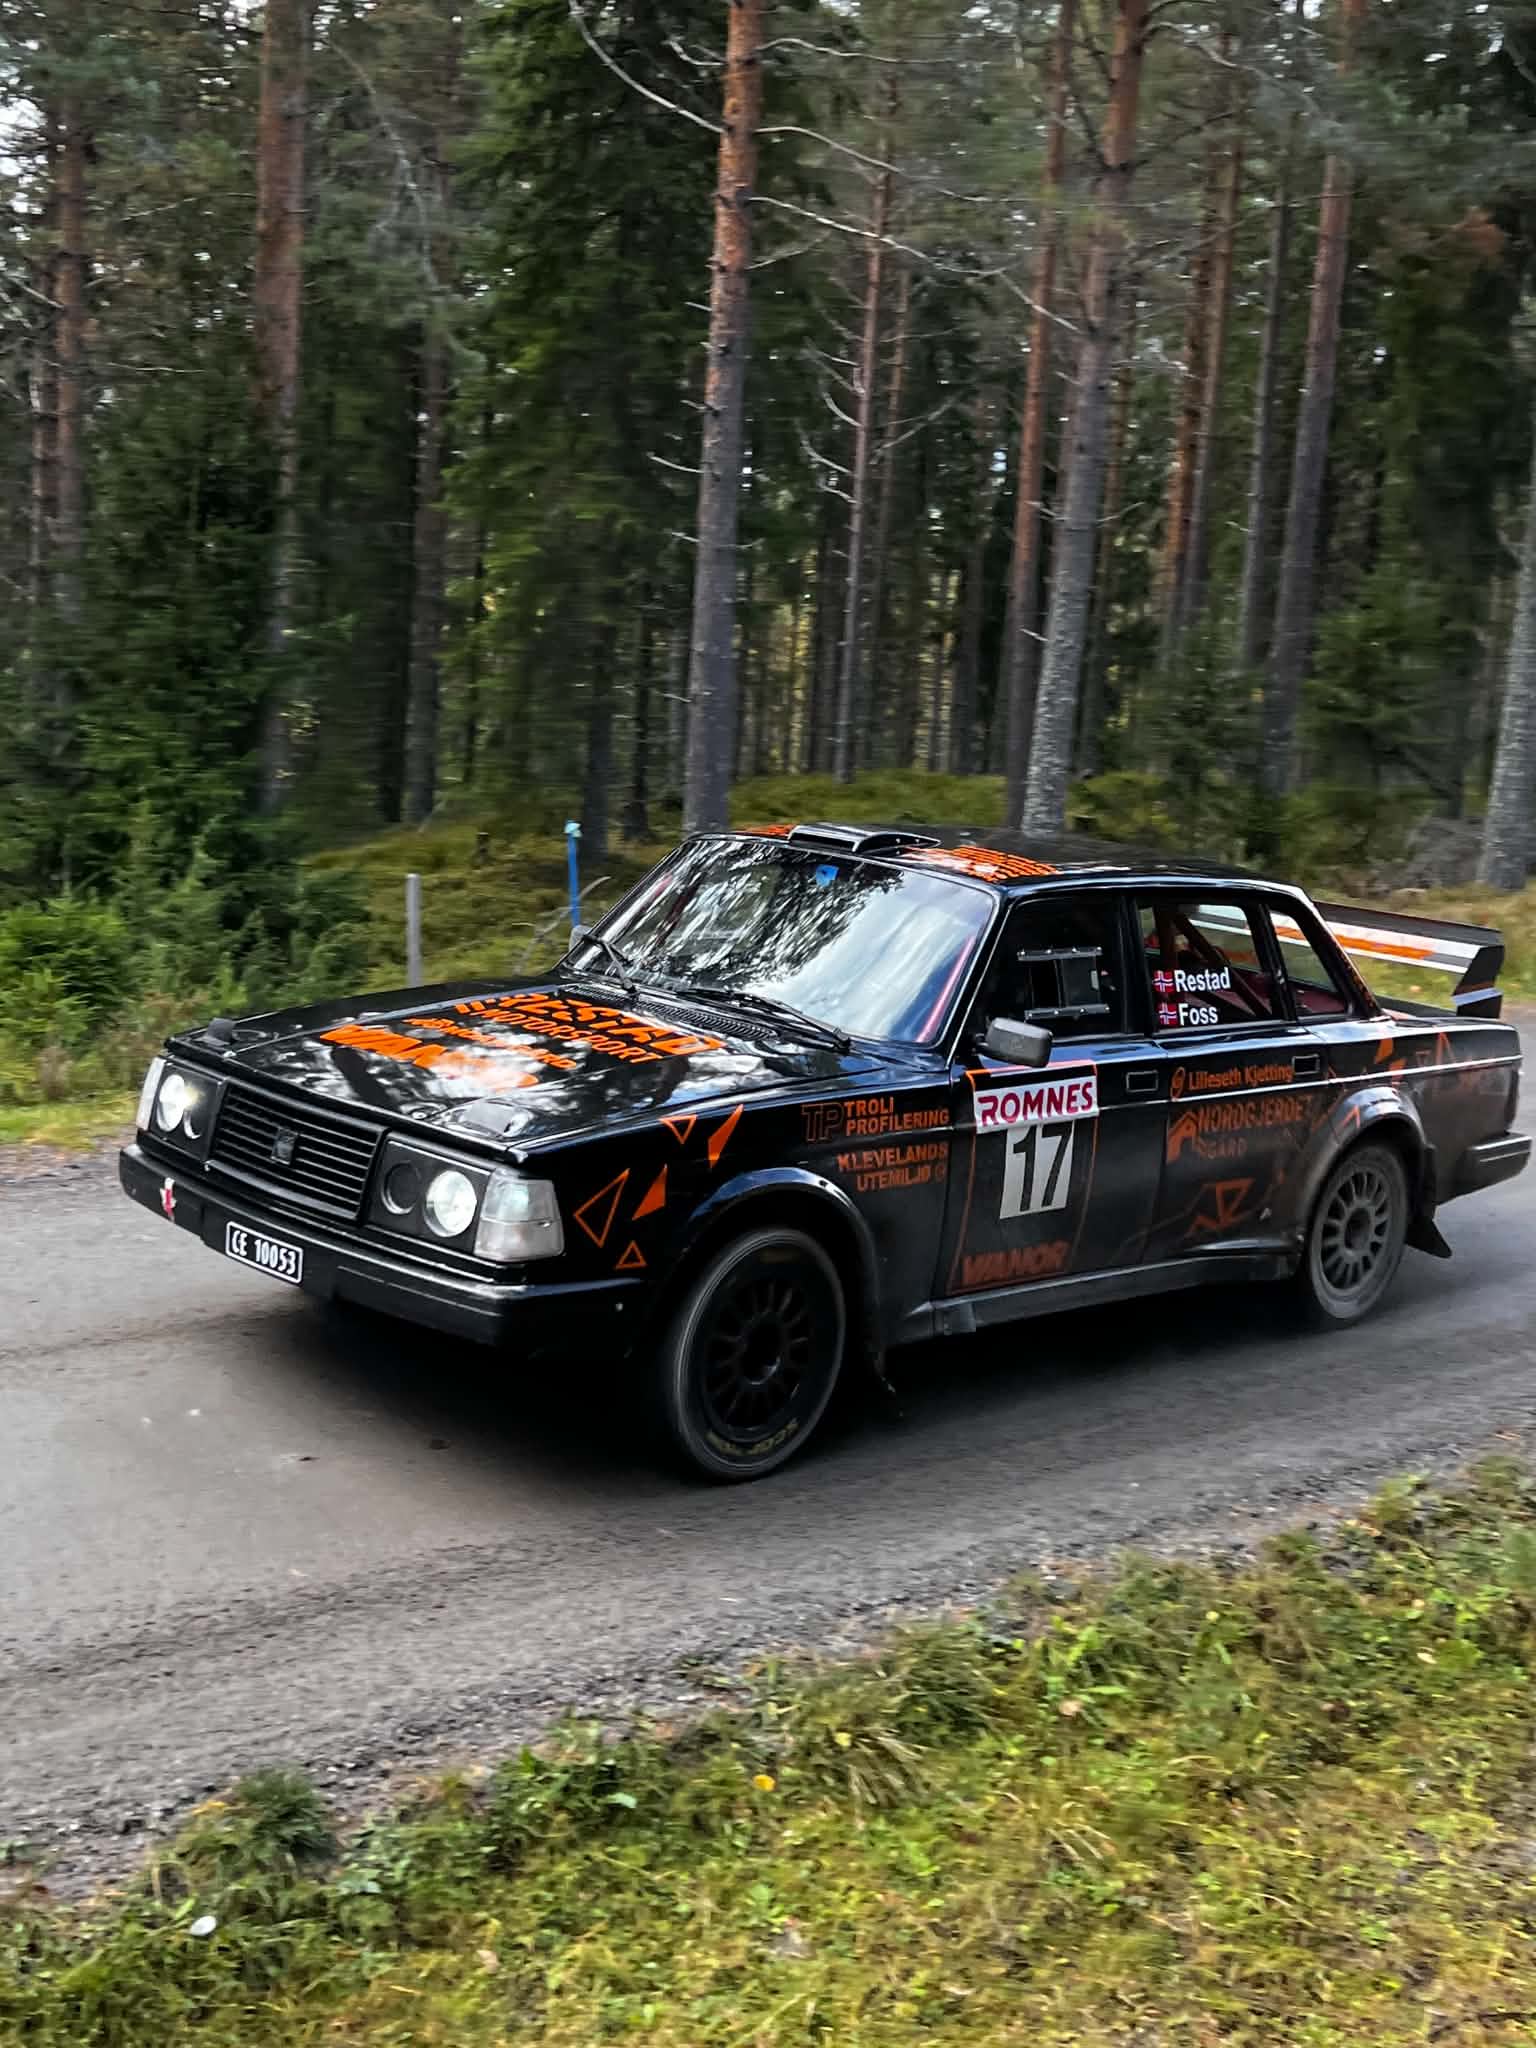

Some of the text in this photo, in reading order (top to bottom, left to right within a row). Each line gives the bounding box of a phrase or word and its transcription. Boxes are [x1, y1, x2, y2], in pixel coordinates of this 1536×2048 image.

[1174, 966, 1231, 992] Restad
[474, 1008, 664, 1063] MOTORSPORT
[499, 993, 727, 1055] RESTAD
[1178, 1003, 1218, 1025] Foss
[846, 1108, 950, 1136] PROFILERING
[977, 1081, 1092, 1127] ROMNES
[836, 1142, 949, 1172] KLEVELANDS
[1013, 1121, 1073, 1212] 17
[231, 1230, 297, 1275] CE 10053
